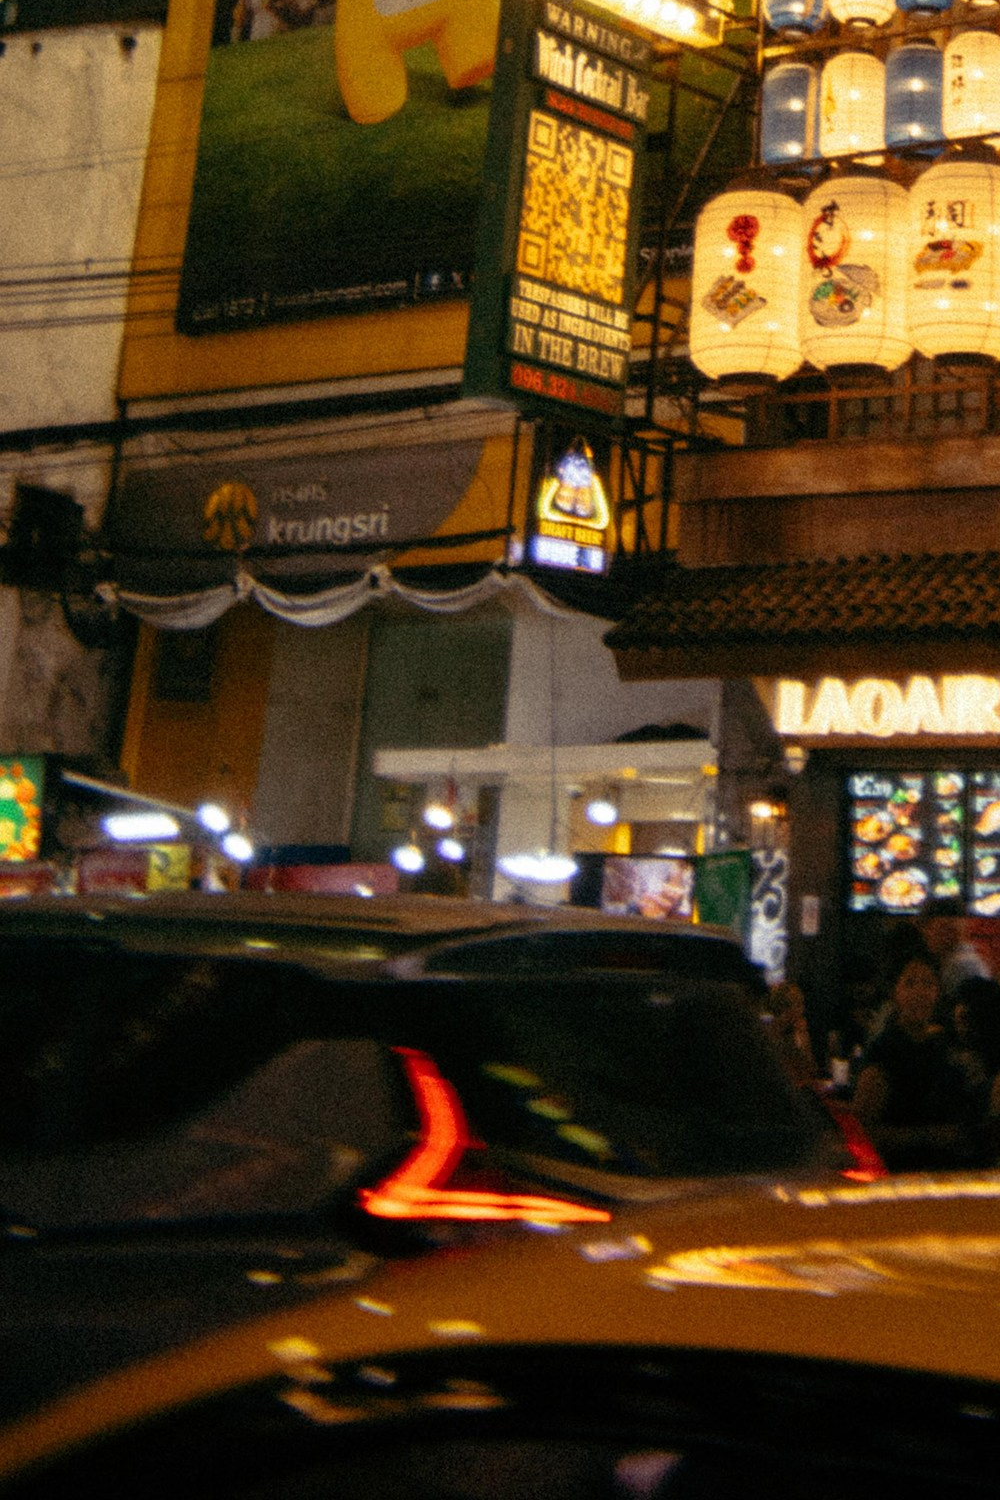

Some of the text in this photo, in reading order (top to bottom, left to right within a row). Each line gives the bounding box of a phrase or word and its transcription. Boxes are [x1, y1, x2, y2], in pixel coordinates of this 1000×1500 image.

[546, 2, 632, 60] WARNING
[513, 323, 625, 382] IN THE BREW
[267, 503, 391, 545] krungsri
